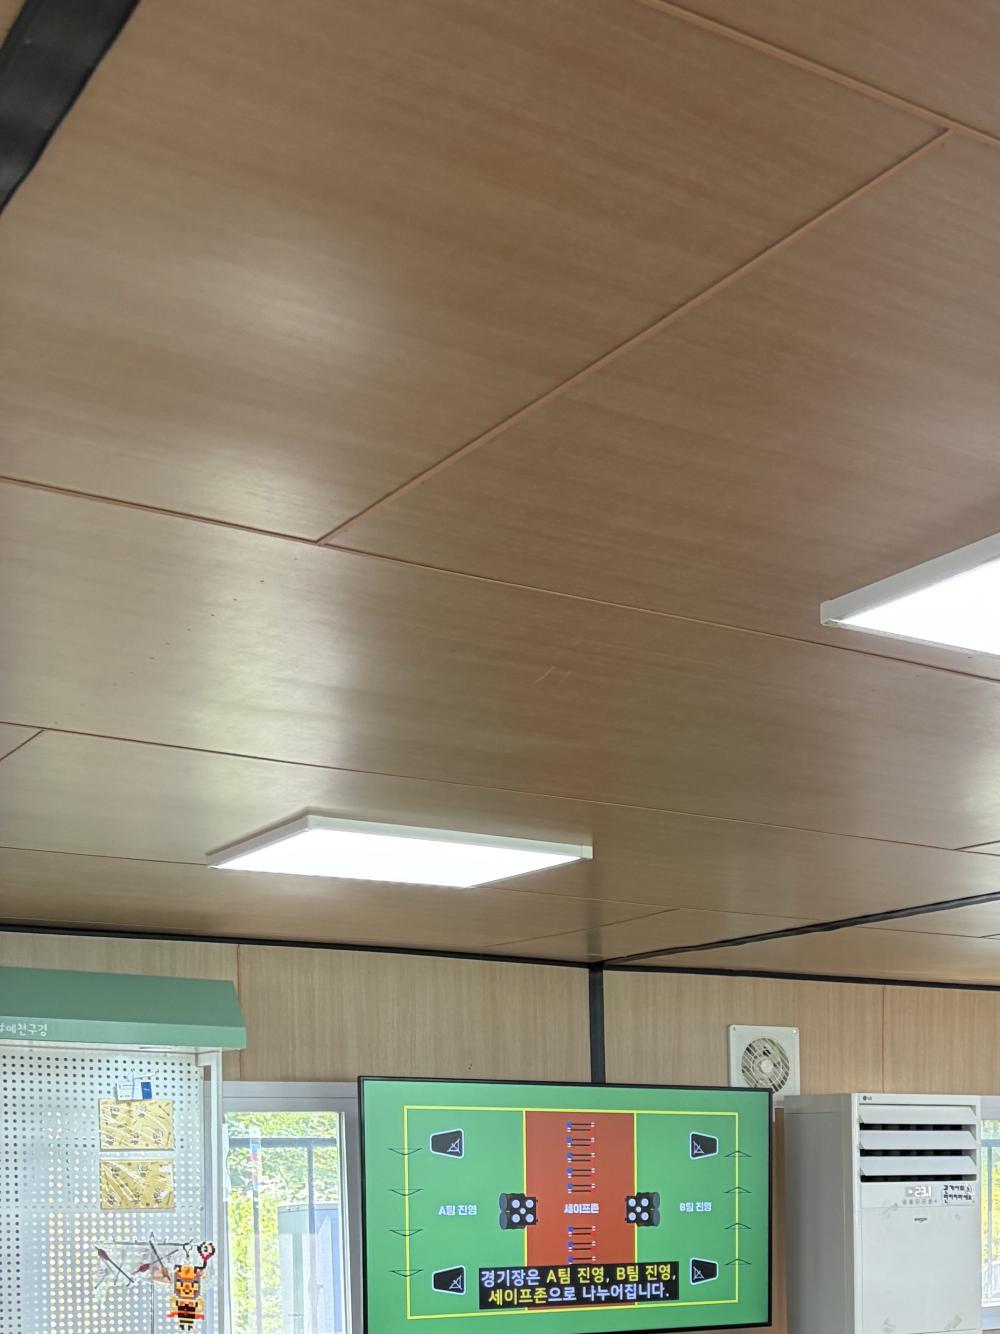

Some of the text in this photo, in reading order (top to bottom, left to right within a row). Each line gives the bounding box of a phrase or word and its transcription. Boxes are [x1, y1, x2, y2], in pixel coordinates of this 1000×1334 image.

[438, 1205, 478, 1216] A팀 진영
[563, 1203, 600, 1215] 세이프존
[679, 1201, 713, 1212] B팀 진영
[480, 1264, 677, 1288] 경기장은 A팀 진영, B팀 진영,
[488, 1282, 670, 1306] 세이프존으로 나누어집니다.
